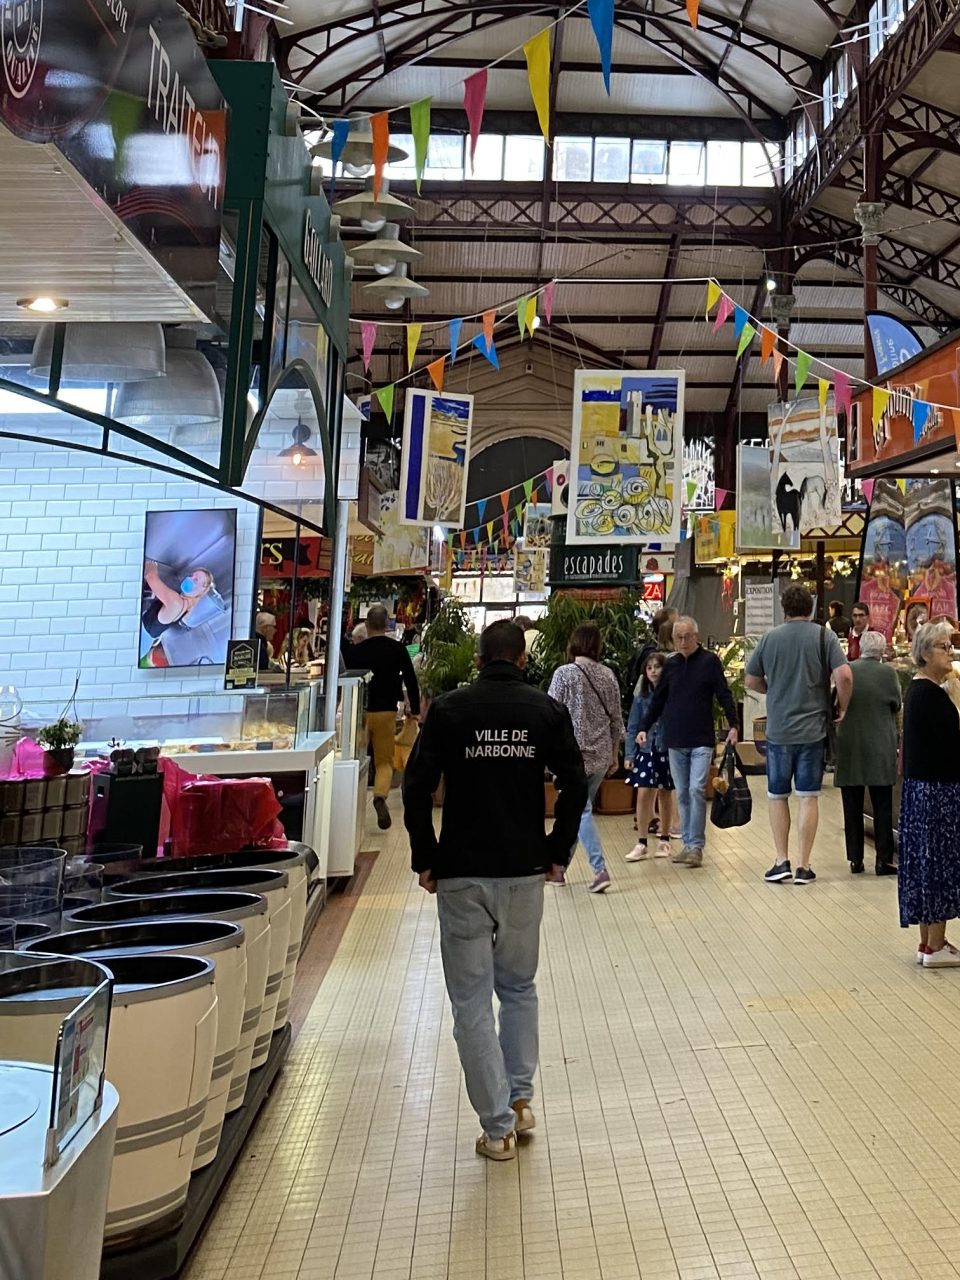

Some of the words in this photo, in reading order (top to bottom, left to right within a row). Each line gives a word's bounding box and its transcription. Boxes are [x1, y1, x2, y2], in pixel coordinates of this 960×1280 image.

[16, 0, 30, 28] DE
[563, 548, 624, 579] escapades
[643, 583, 662, 599] ZA
[475, 729, 509, 742] VILLE
[511, 729, 529, 742] DE
[465, 744, 536, 759] NARBONNE
